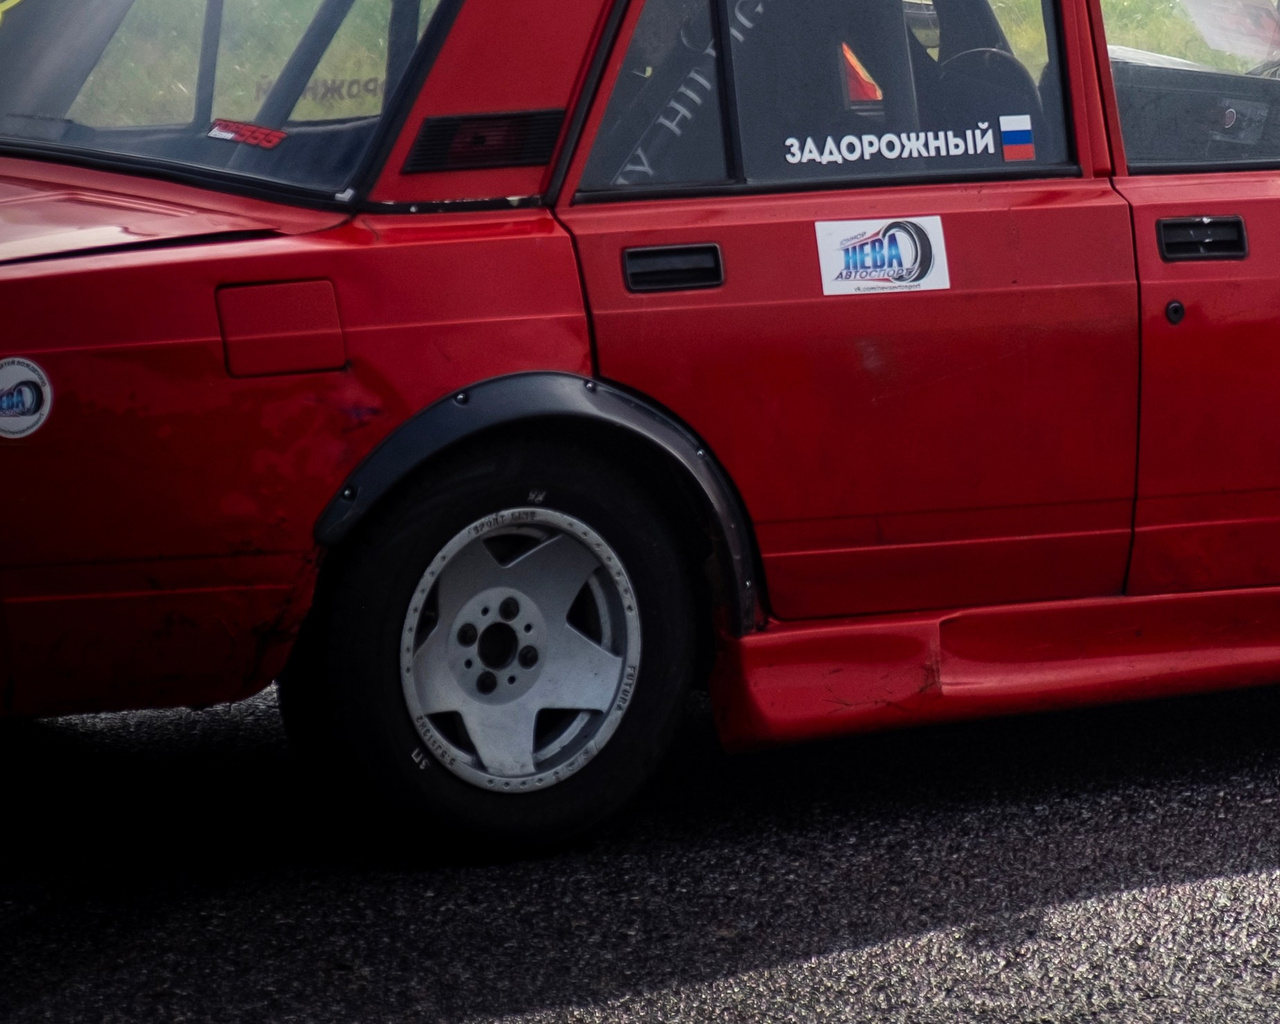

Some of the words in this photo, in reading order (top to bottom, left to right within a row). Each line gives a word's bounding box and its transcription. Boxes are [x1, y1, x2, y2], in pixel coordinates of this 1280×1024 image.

[784, 122, 995, 164] ЗАДОРОЖНЫЙ
[842, 232, 903, 271] НЕВА
[835, 266, 915, 281] АВТОСПОРТ
[616, 664, 637, 713] FUTURA
